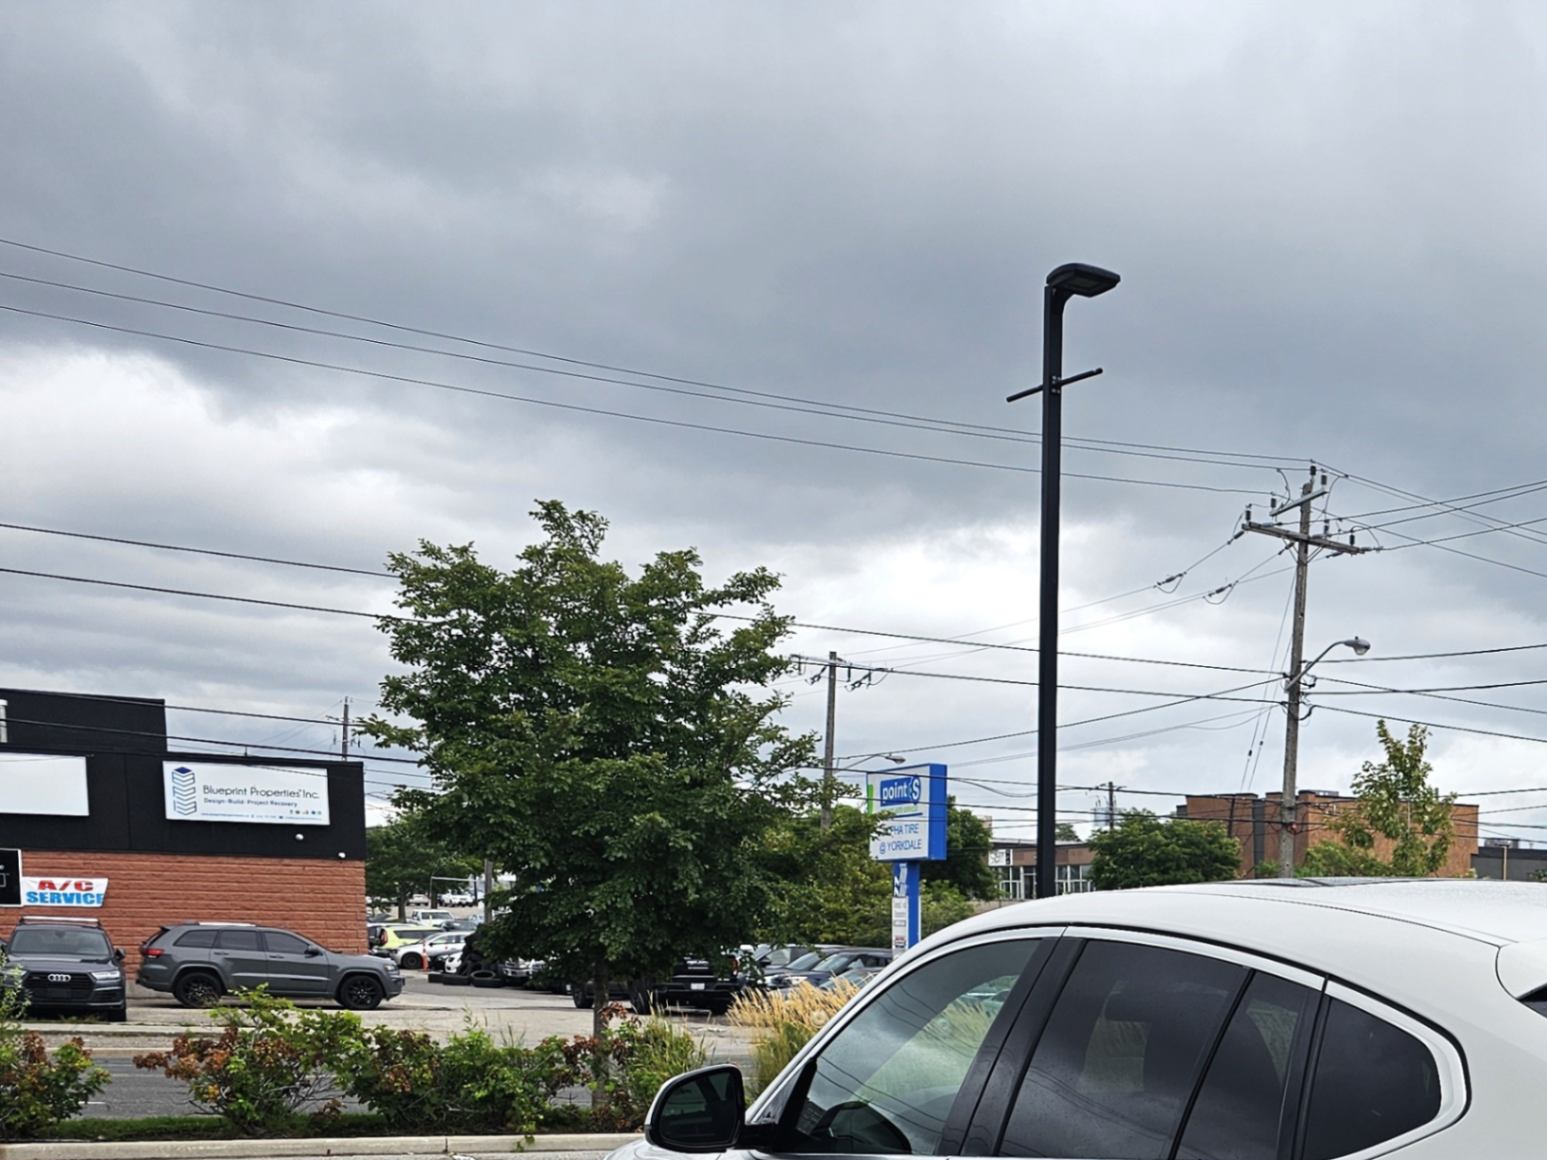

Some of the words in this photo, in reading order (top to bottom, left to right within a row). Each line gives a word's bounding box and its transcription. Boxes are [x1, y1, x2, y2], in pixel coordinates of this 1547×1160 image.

[203, 784, 247, 796] Blueprint
[303, 789, 320, 799] Inc.
[882, 782, 908, 804] point
[887, 839, 922, 851] YORKDALE
[38, 880, 94, 891] A/C
